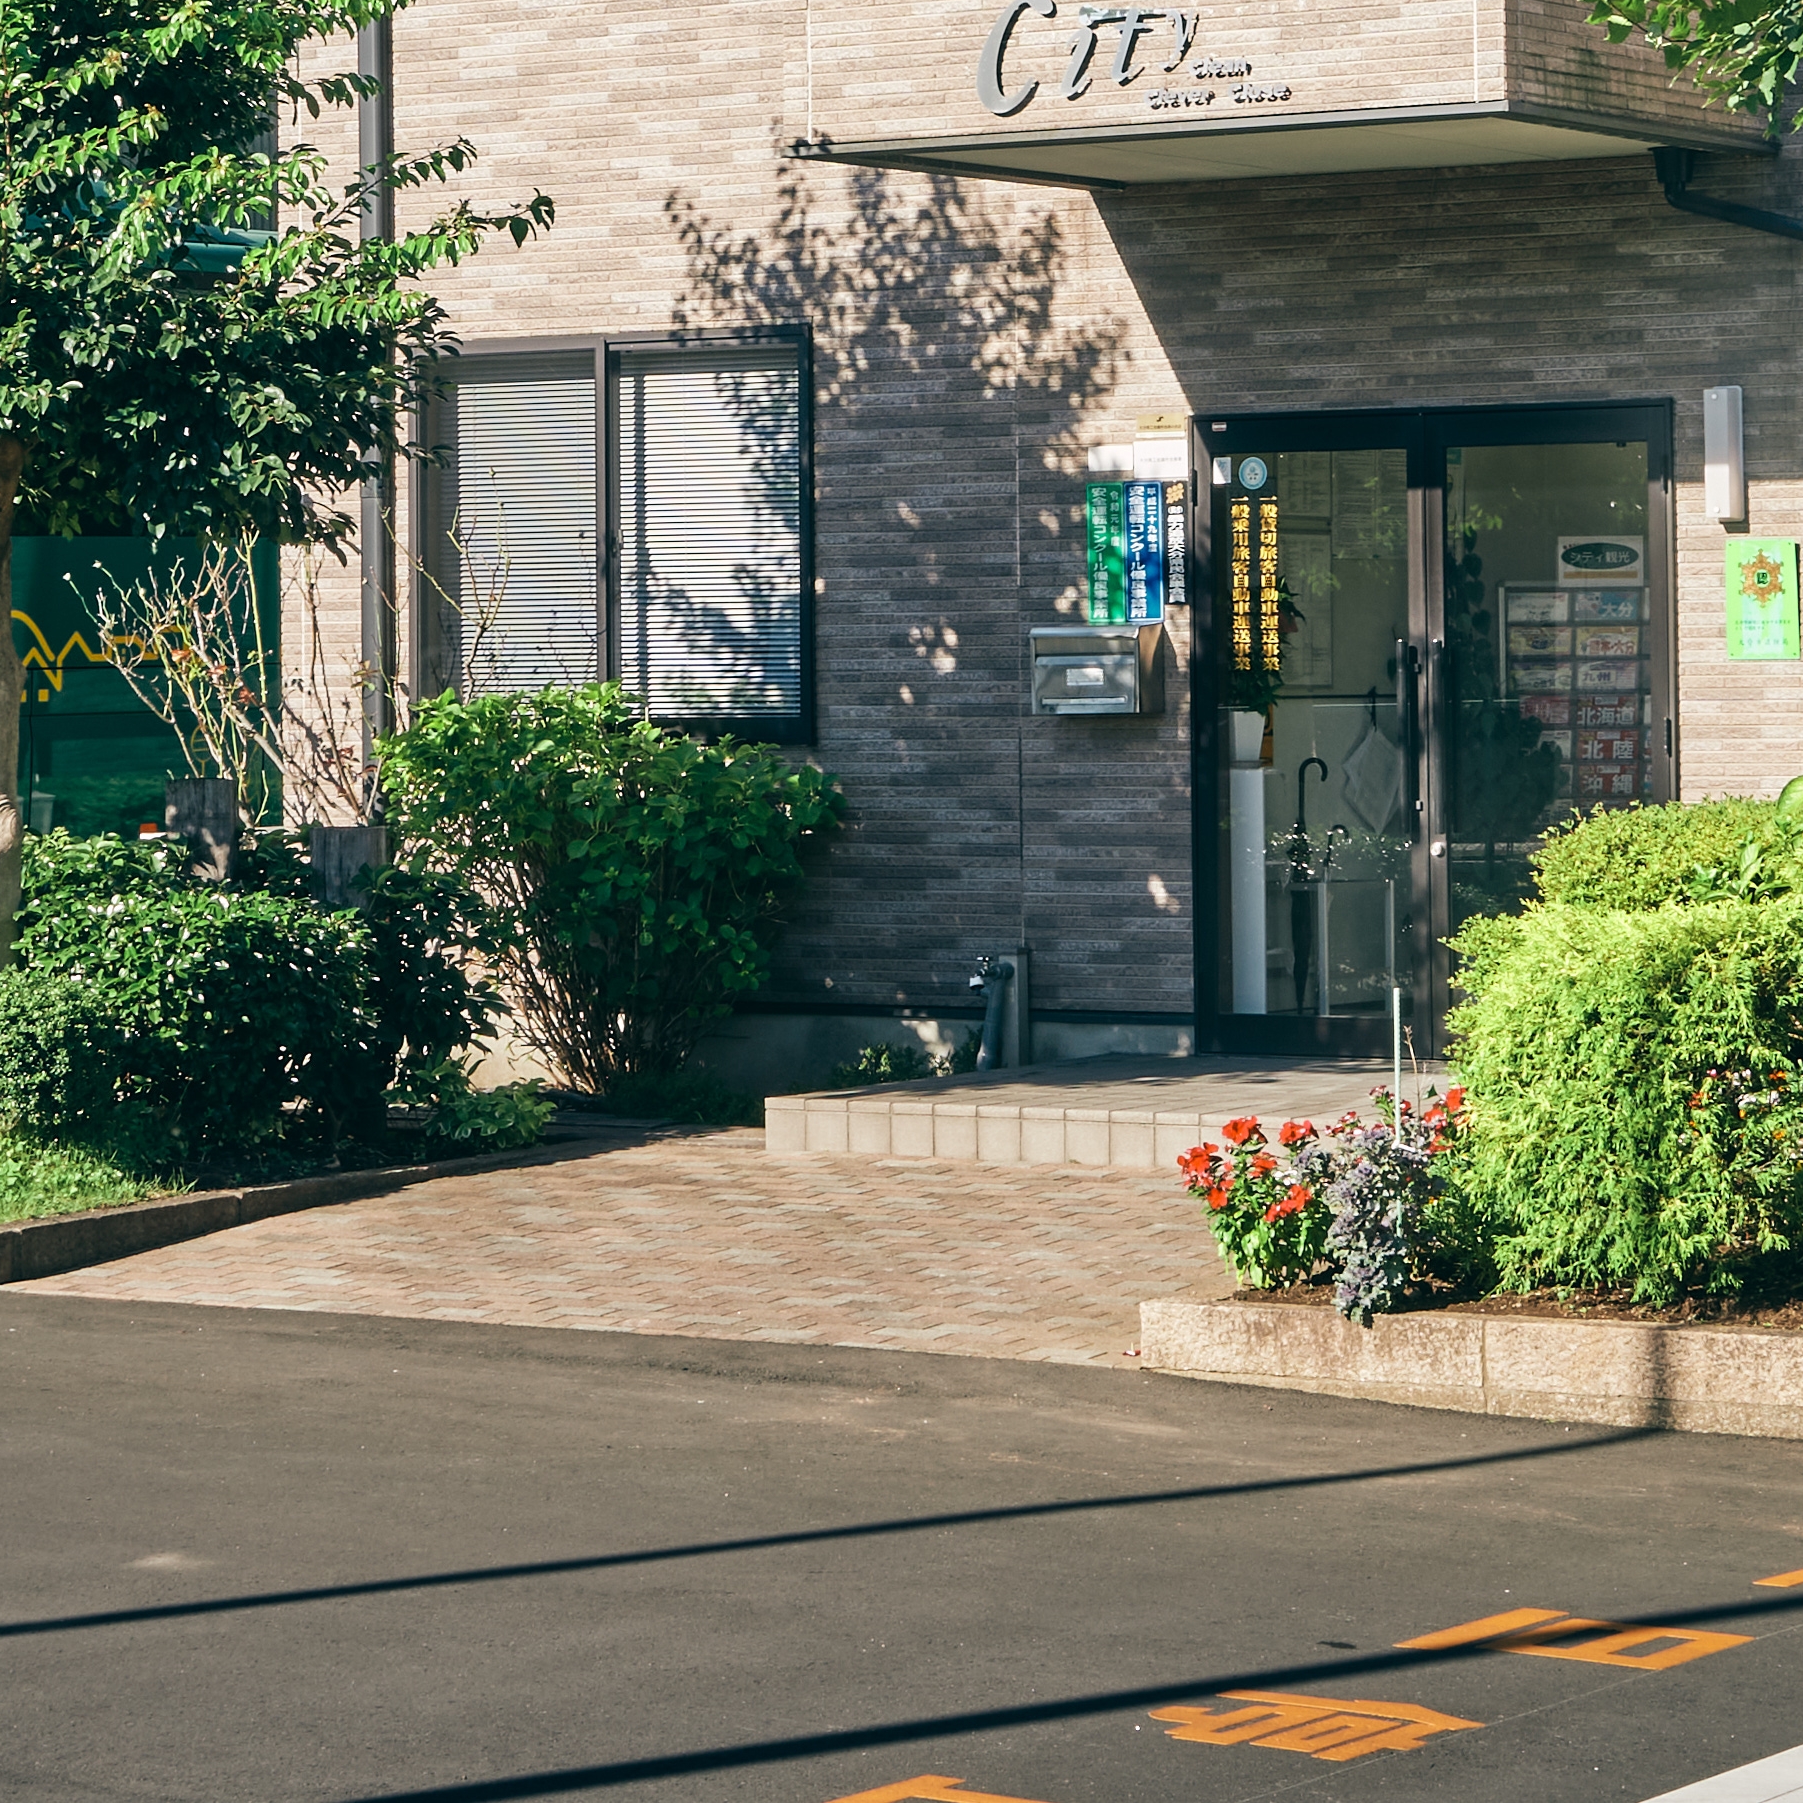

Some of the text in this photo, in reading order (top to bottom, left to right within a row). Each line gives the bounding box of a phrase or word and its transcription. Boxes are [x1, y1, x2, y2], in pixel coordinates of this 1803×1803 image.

[1190, 57, 1252, 78] Clean
[1146, 82, 1292, 110] Clever Close
[1569, 551, 1631, 564] シティ観光
[1231, 496, 1251, 670] 一般乗用旅客自動車運送事業
[1259, 496, 1279, 670] 一般貸切旅客自動車運送事業
[1602, 602, 1634, 617] 大分
[1577, 707, 1635, 725] 北海道
[1582, 740, 1634, 759] 北陸
[1583, 774, 1634, 794] 沖縄
